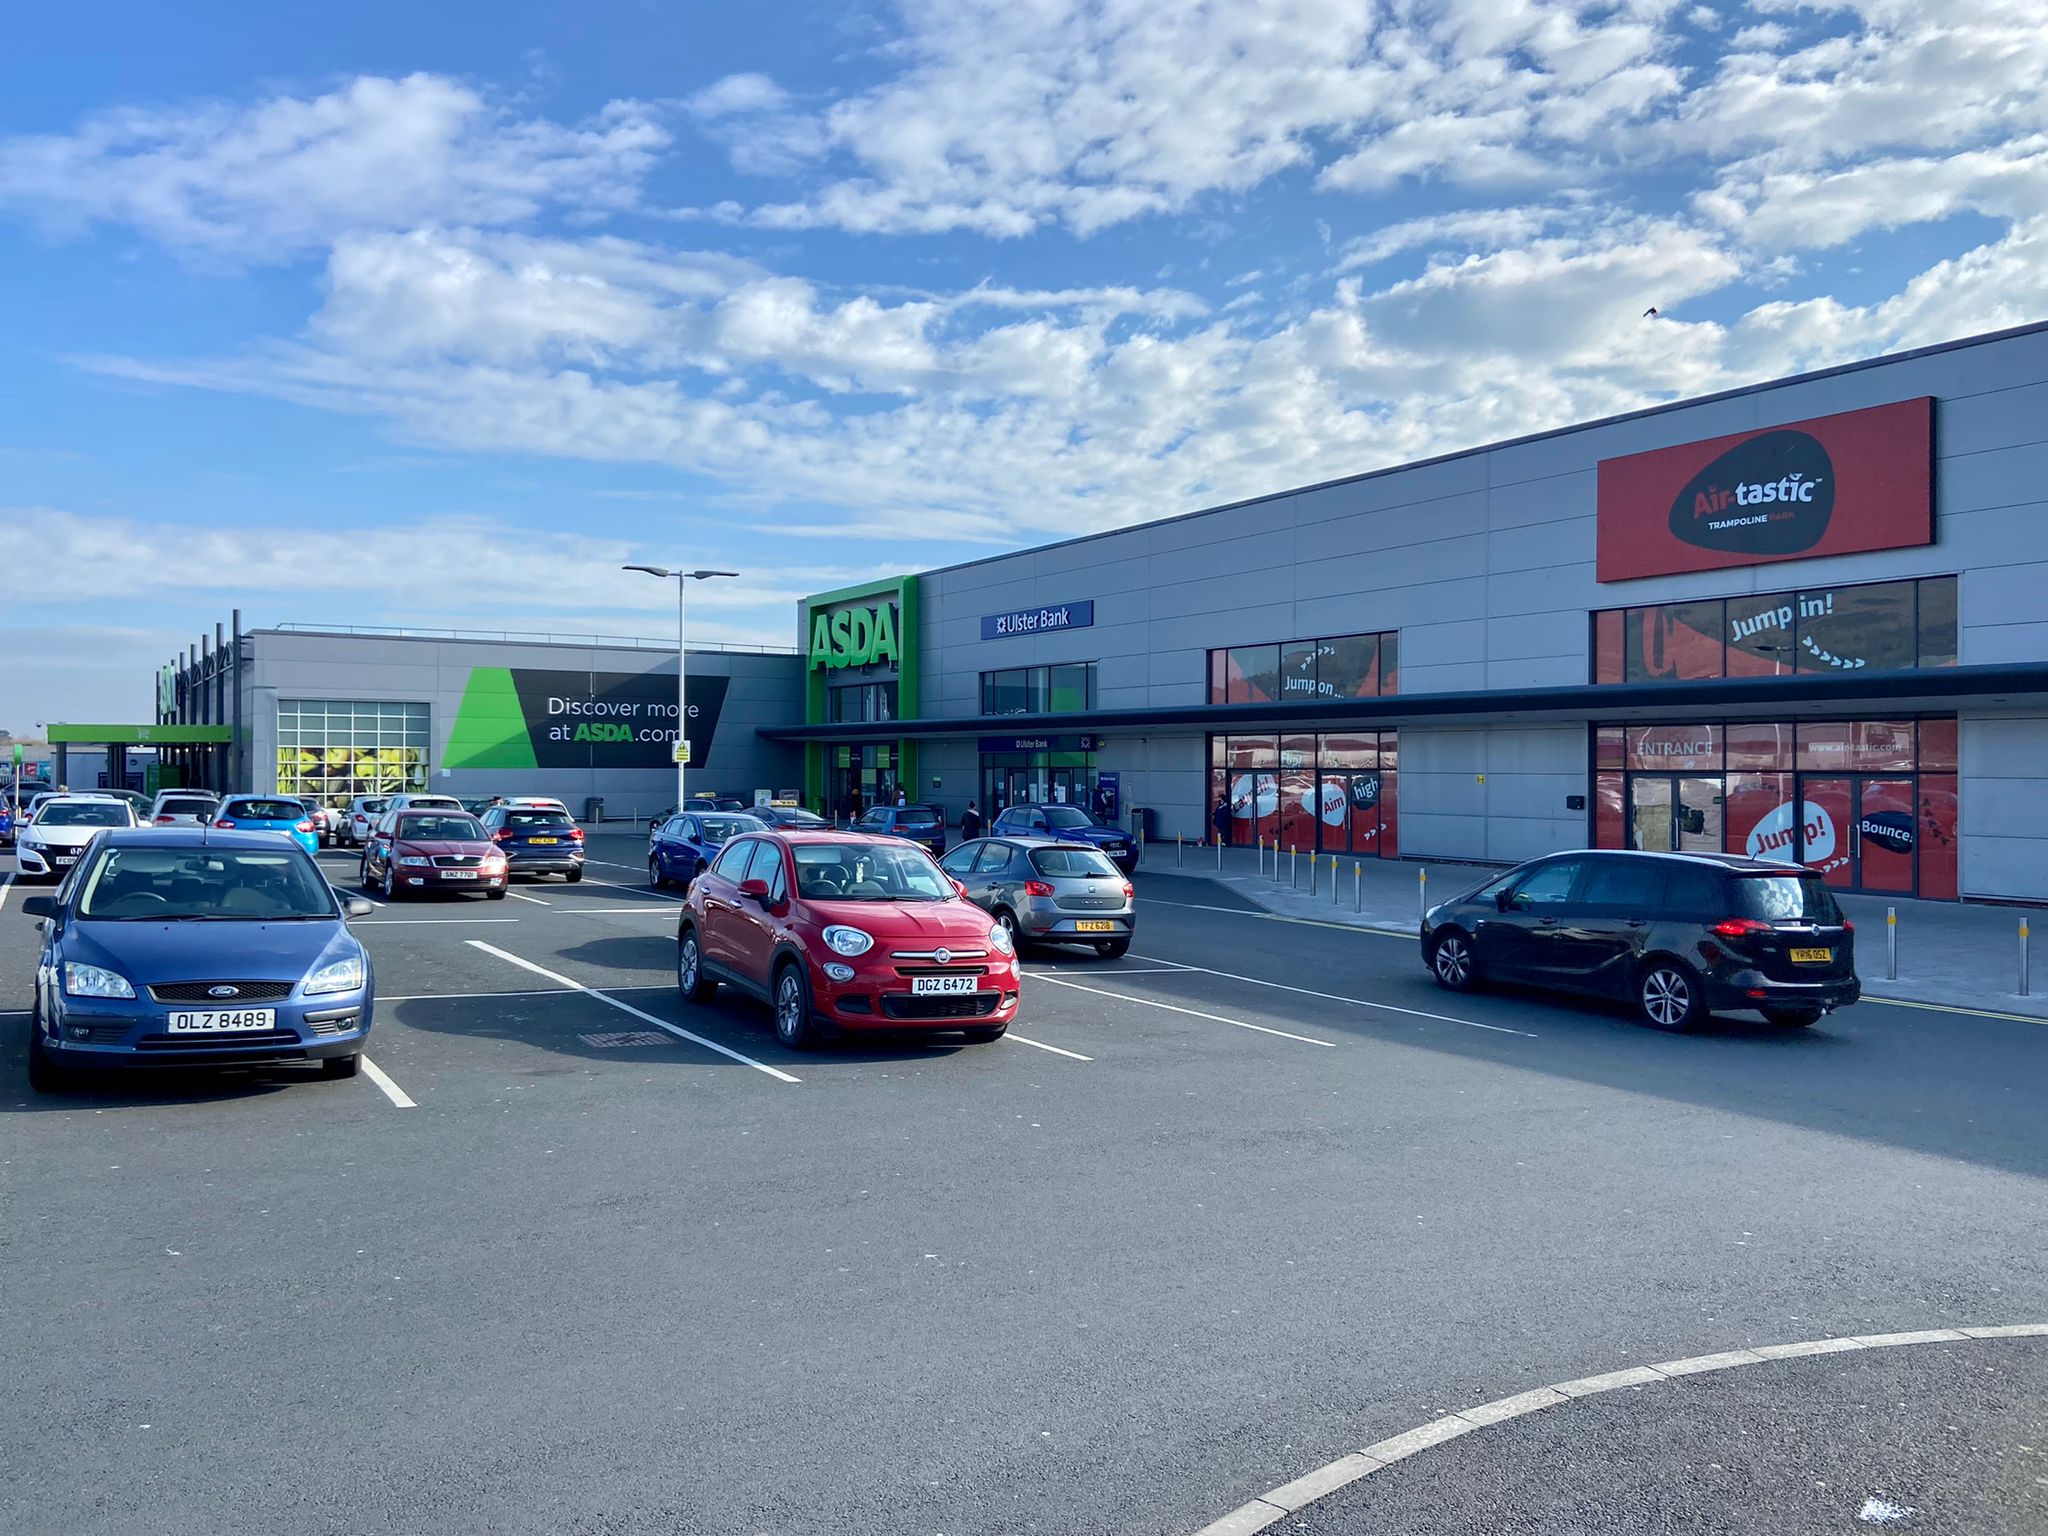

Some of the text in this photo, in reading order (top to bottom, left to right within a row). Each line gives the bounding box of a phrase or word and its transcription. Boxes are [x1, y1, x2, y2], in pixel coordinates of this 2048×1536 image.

[1708, 511, 1795, 530] TRAMPOLINE PARK
[1007, 607, 1069, 632] Ulster Bank
[1731, 593, 1833, 642] Jump in!
[809, 602, 898, 671] ASDA
[1285, 676, 1316, 694] Jump
[548, 698, 640, 717] Discover
[549, 724, 571, 741] at
[1021, 739, 1048, 749] Ulster Bank
[1637, 741, 1712, 756] ENTRANCE
[1353, 778, 1378, 800] high
[1324, 797, 1345, 814] Aim
[1080, 921, 1094, 929] TFZ
[917, 978, 973, 991] DGZ 6472
[177, 1011, 266, 1030] OLZ 8489
